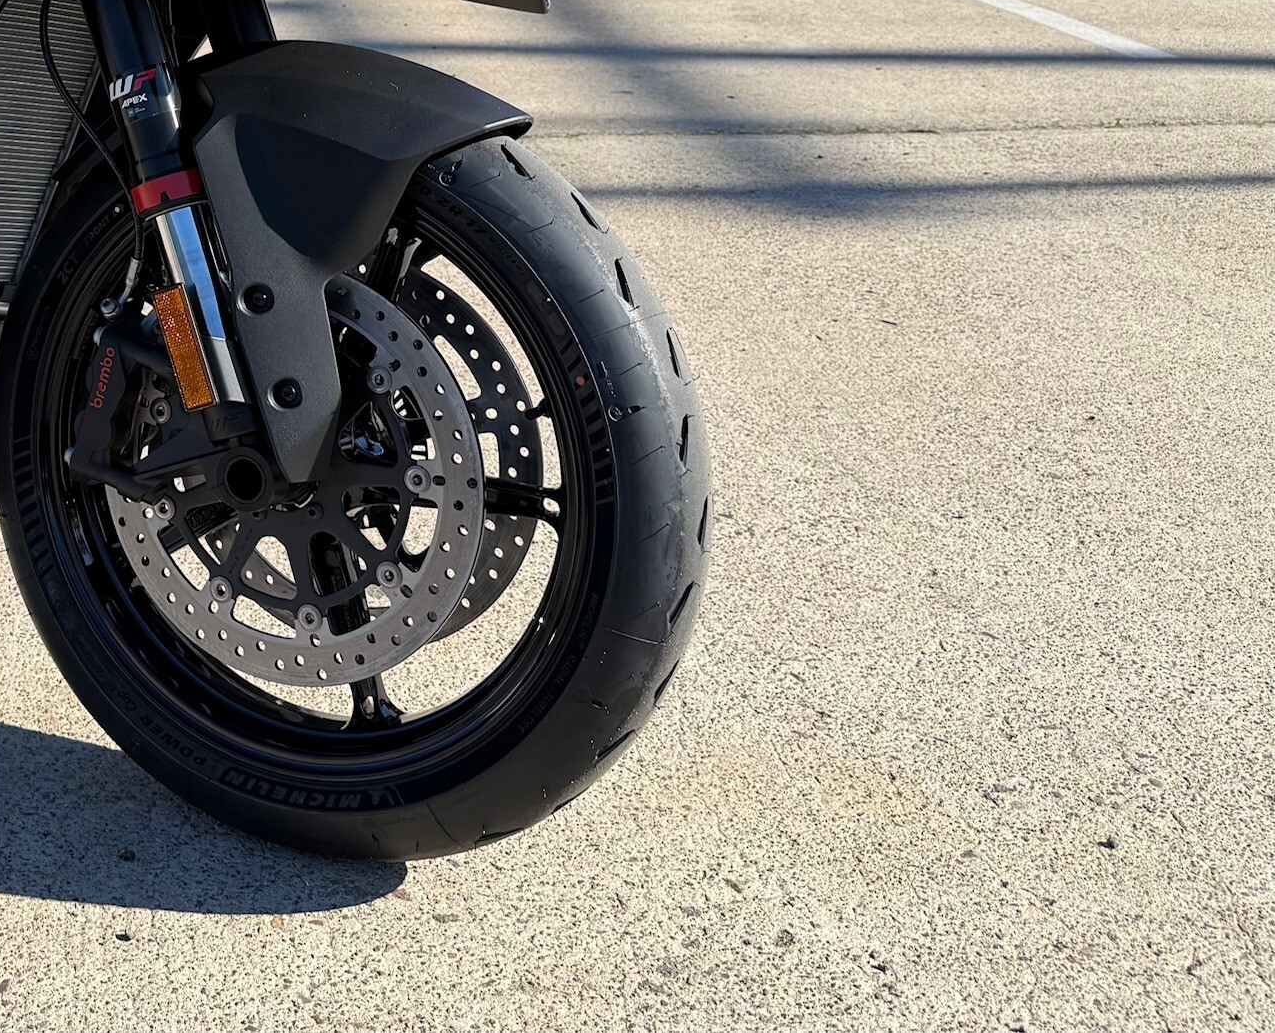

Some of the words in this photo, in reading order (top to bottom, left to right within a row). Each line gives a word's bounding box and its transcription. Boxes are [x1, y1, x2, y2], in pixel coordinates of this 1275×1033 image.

[109, 68, 156, 102] WP
[121, 92, 148, 110] APEX
[90, 346, 115, 410] brembo
[139, 714, 208, 767] POWER
[223, 769, 363, 809] MICHELIN
